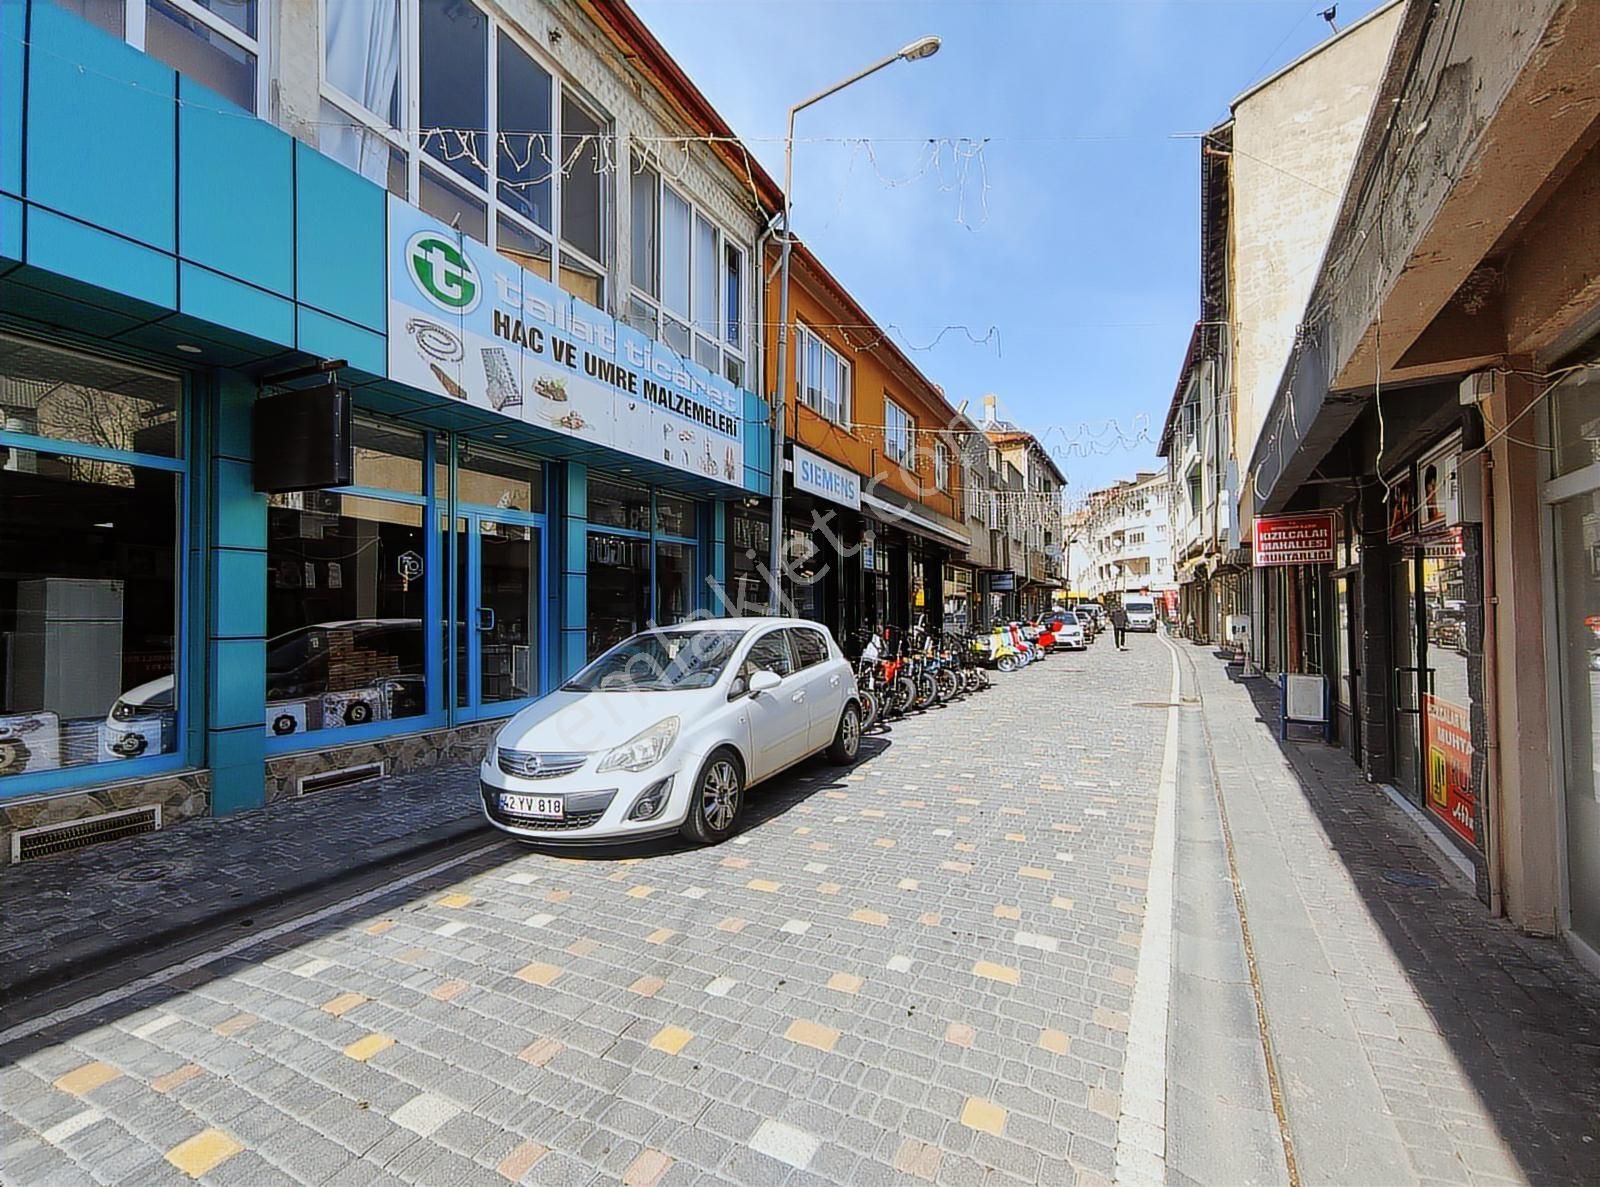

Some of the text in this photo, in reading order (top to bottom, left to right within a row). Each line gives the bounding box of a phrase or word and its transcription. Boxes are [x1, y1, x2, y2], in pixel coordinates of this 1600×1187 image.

[493, 309, 544, 354] HAC
[551, 335, 577, 369] VE
[584, 351, 638, 395] UMRE
[495, 272, 738, 413] talat ticaret
[801, 460, 855, 500] SIEMENS
[504, 795, 561, 814] 42 YV 818
